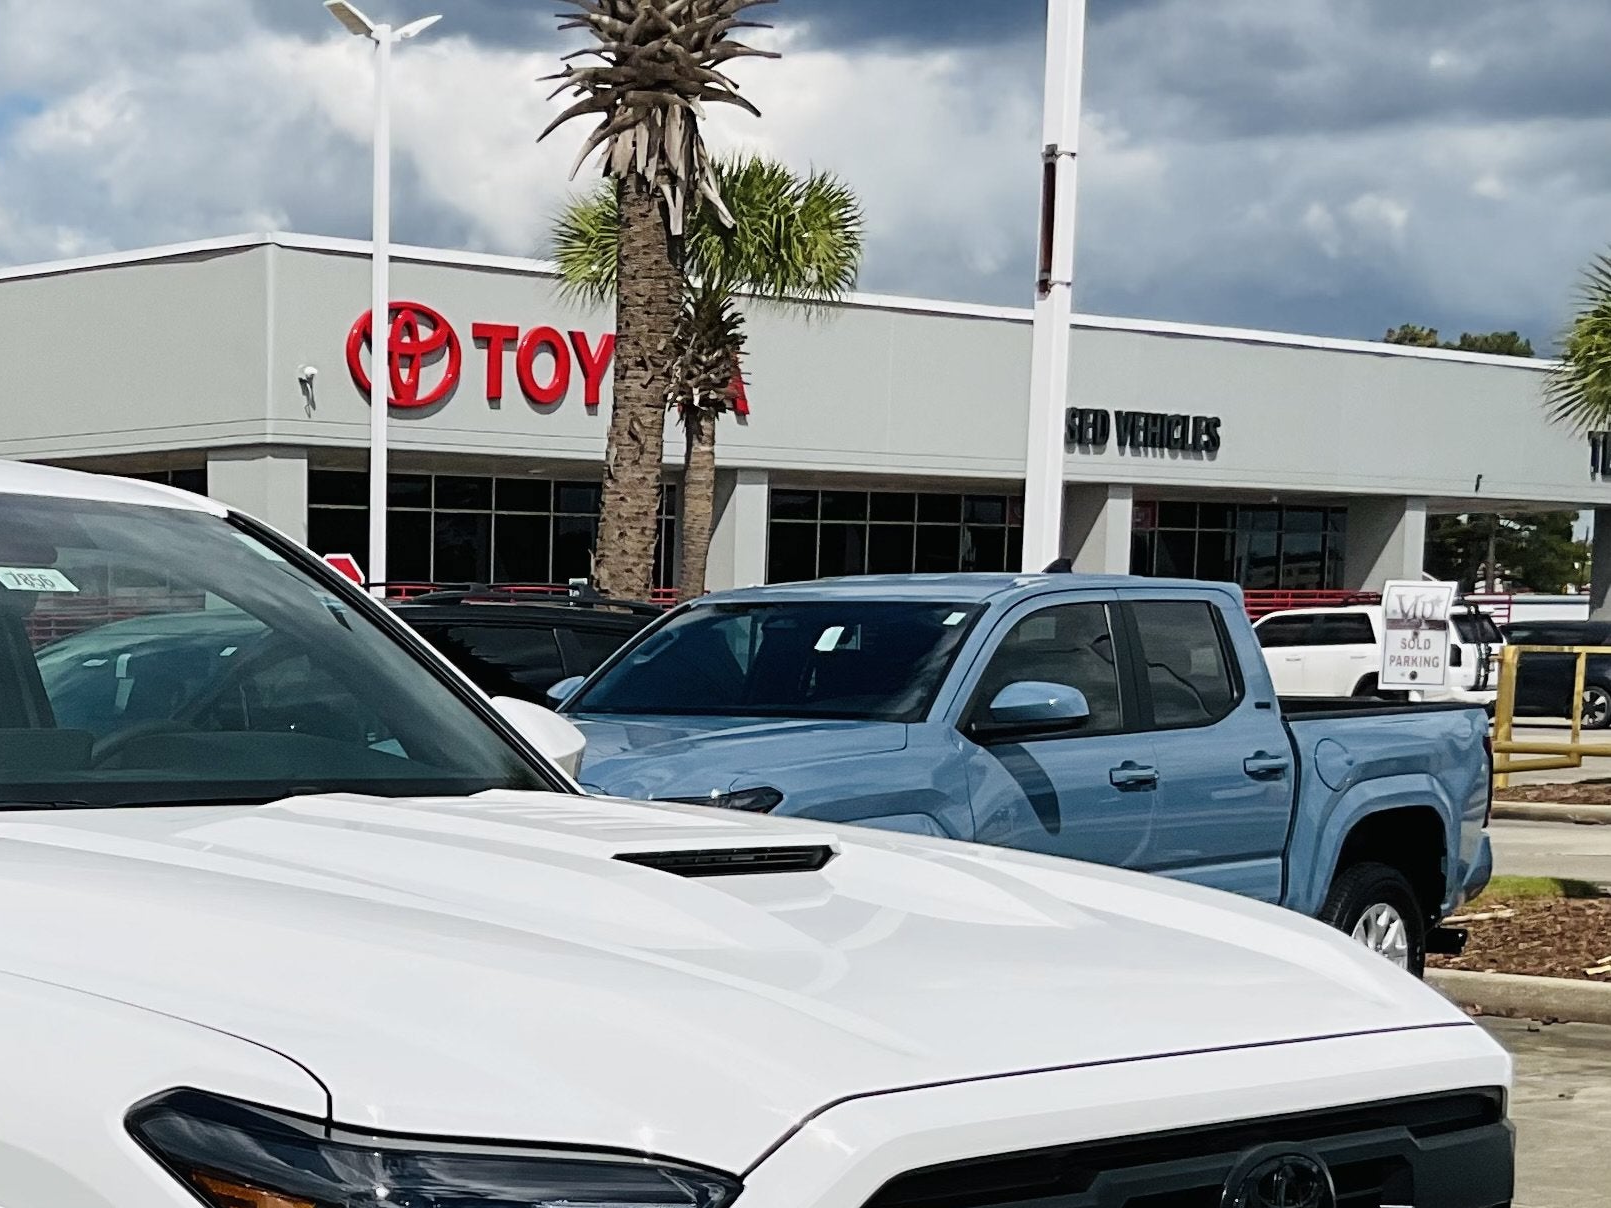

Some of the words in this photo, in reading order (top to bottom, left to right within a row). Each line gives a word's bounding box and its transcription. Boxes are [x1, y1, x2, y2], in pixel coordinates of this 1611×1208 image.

[1064, 407, 1110, 445] SED
[1114, 410, 1221, 451] VEHICLES
[1400, 637, 1431, 651] SOLD
[1389, 655, 1440, 669] PARKING
